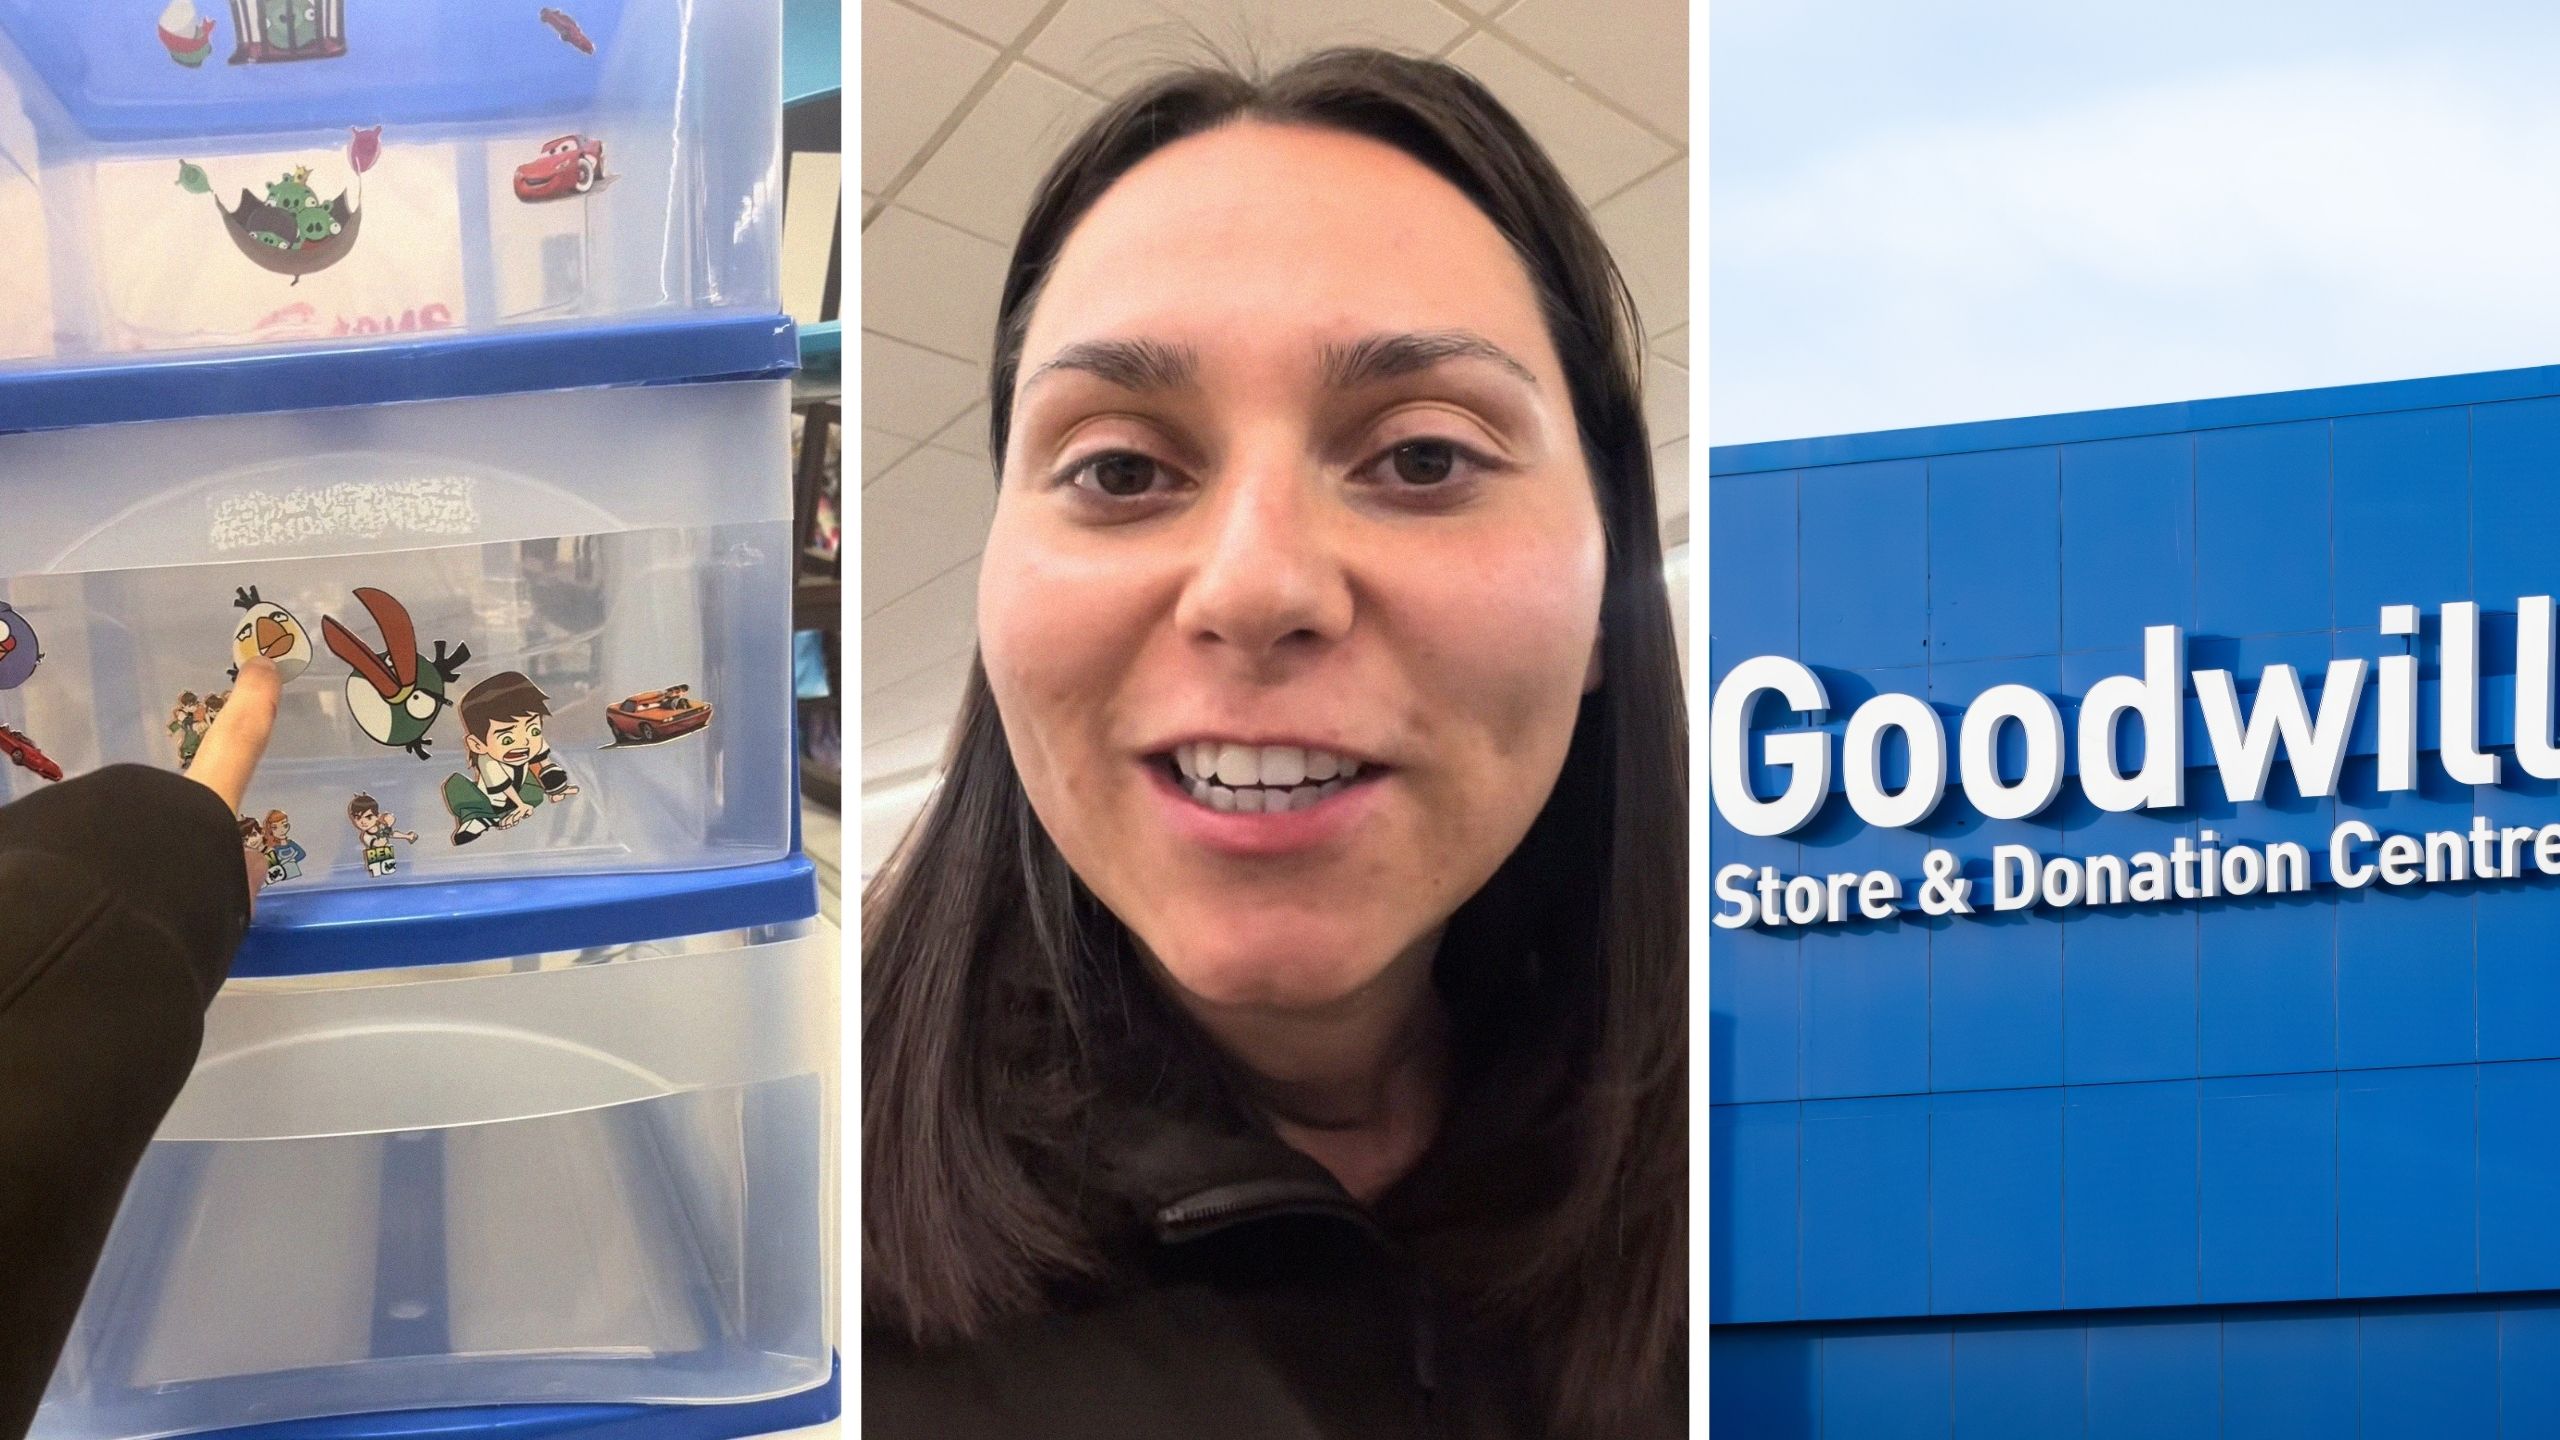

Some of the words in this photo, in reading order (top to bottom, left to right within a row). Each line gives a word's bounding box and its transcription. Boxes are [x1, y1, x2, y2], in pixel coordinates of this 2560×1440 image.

[1710, 595, 2560, 837] Goodwill
[366, 846, 395, 863] BEN
[1712, 863, 1902, 930] Store
[1918, 849, 1976, 916] &
[1993, 829, 2311, 912] Donation
[2330, 815, 2560, 889] Centre
